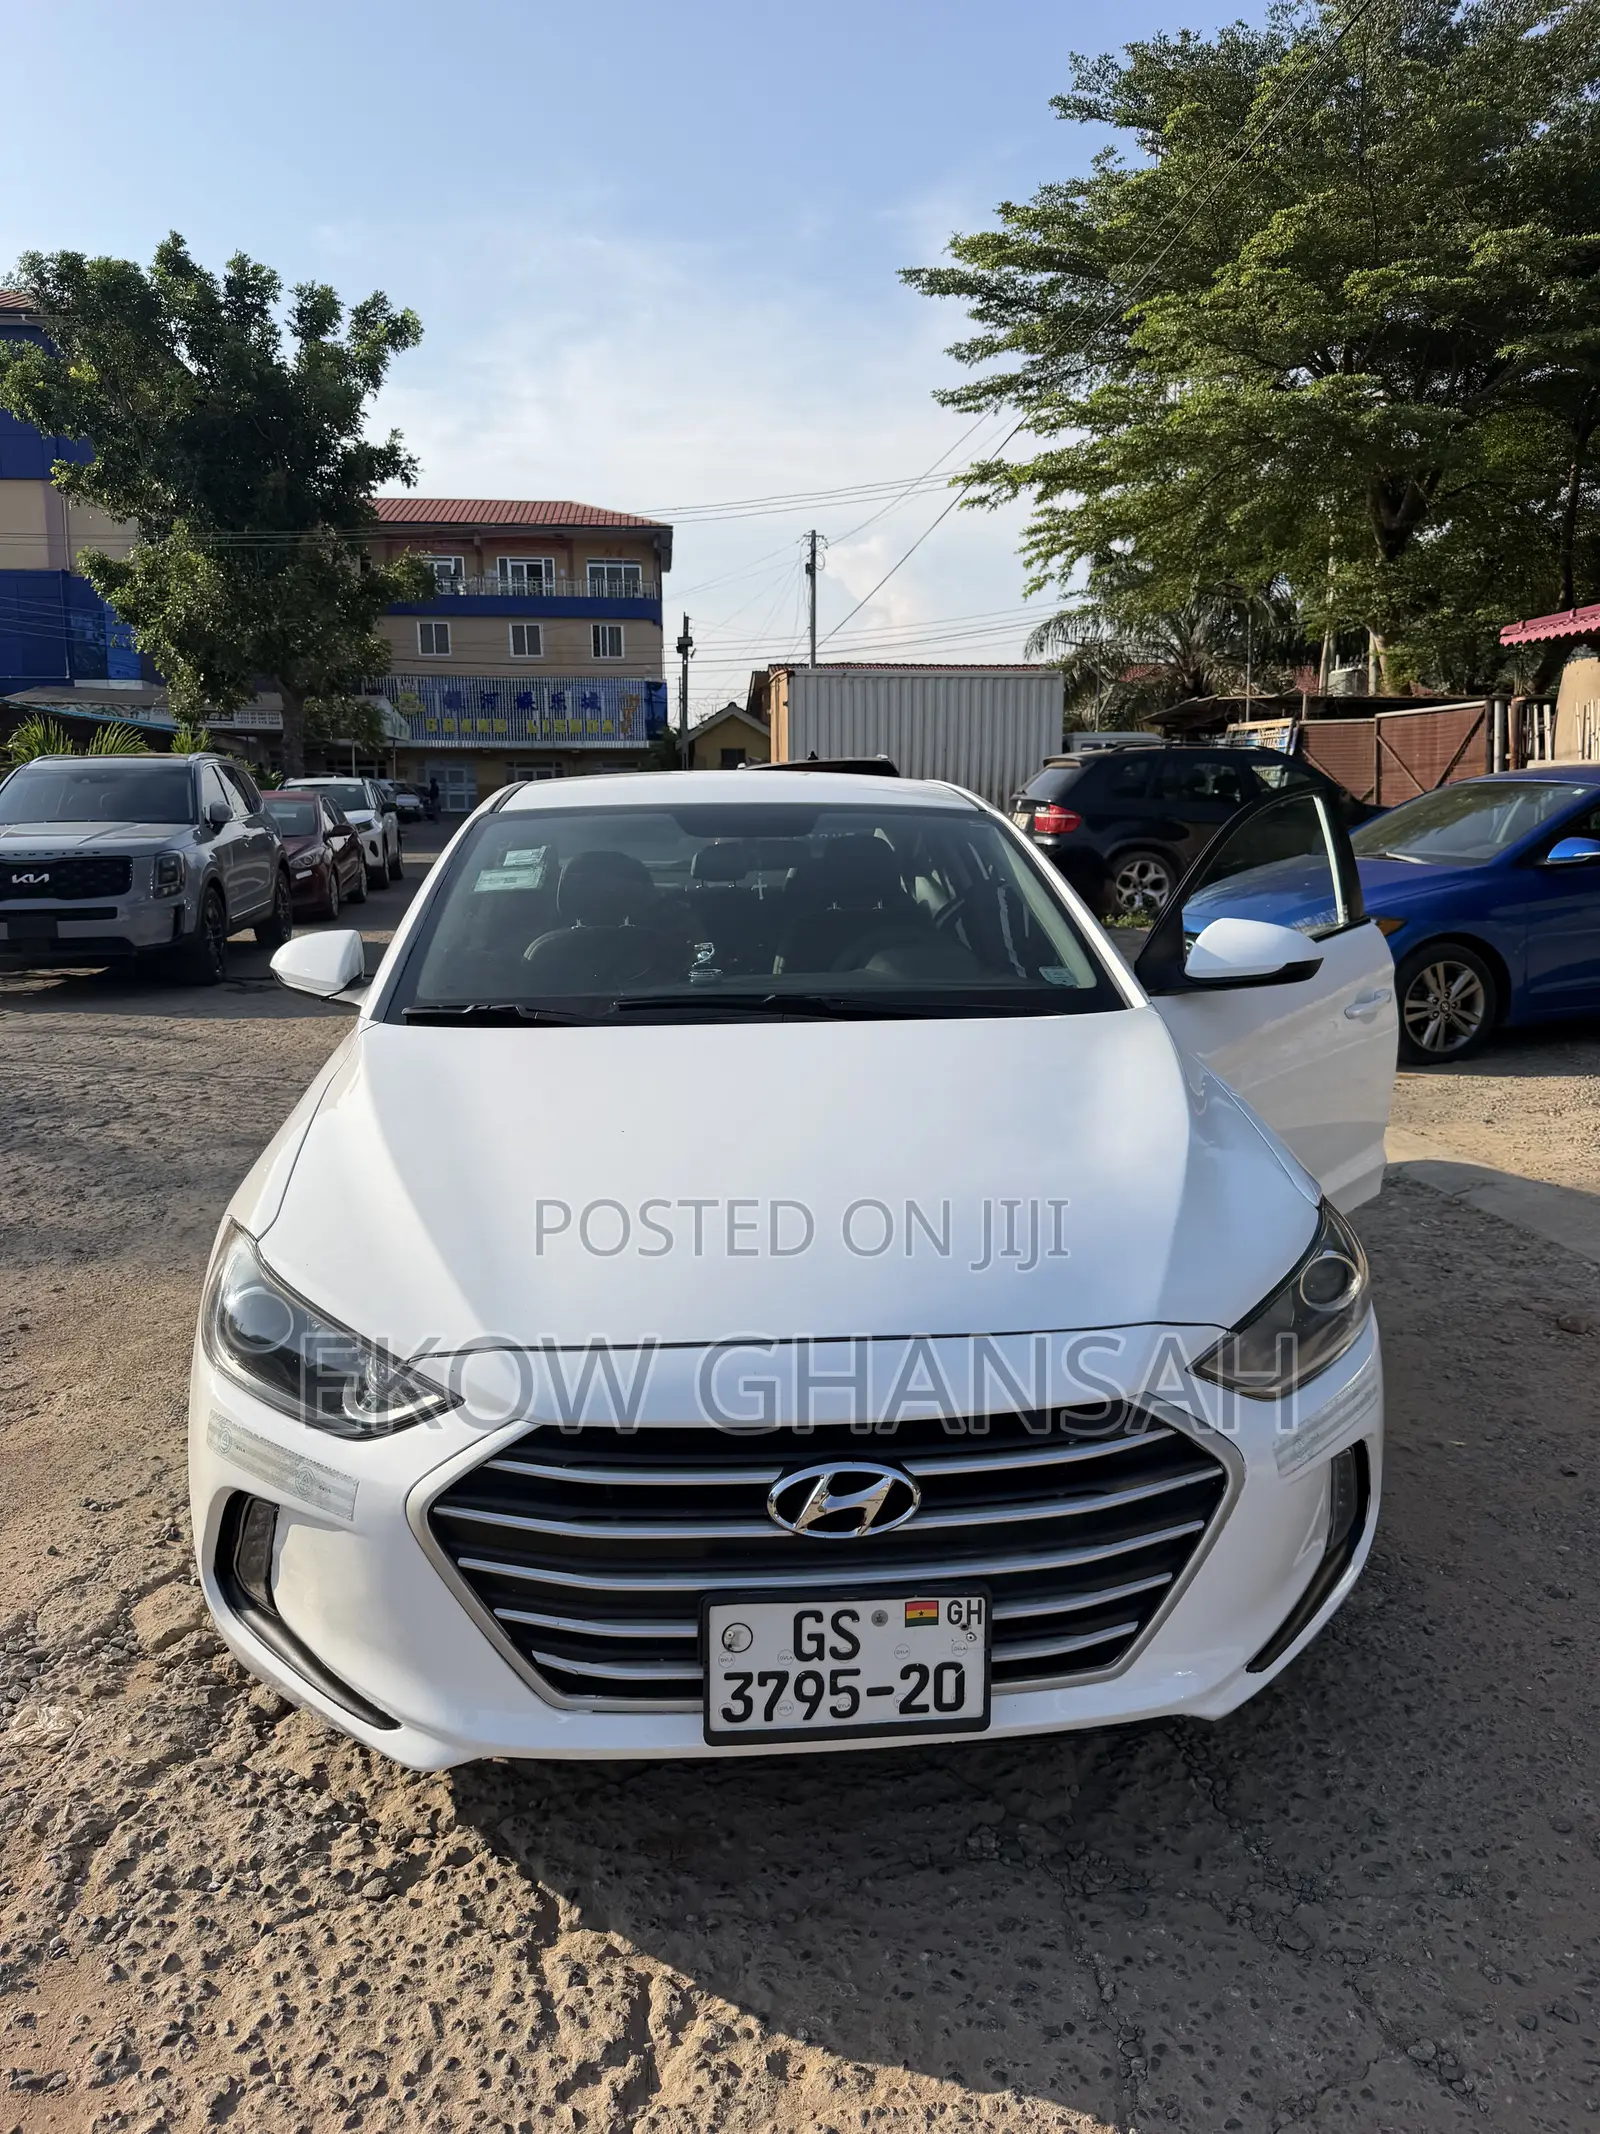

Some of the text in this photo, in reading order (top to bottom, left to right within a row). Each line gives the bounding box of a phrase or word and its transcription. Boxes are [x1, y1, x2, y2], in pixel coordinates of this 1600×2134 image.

[12, 873, 50, 884] KIA
[947, 1599, 982, 1625] GH
[793, 1609, 861, 1662] GS
[721, 1661, 965, 1723] 3795-20
